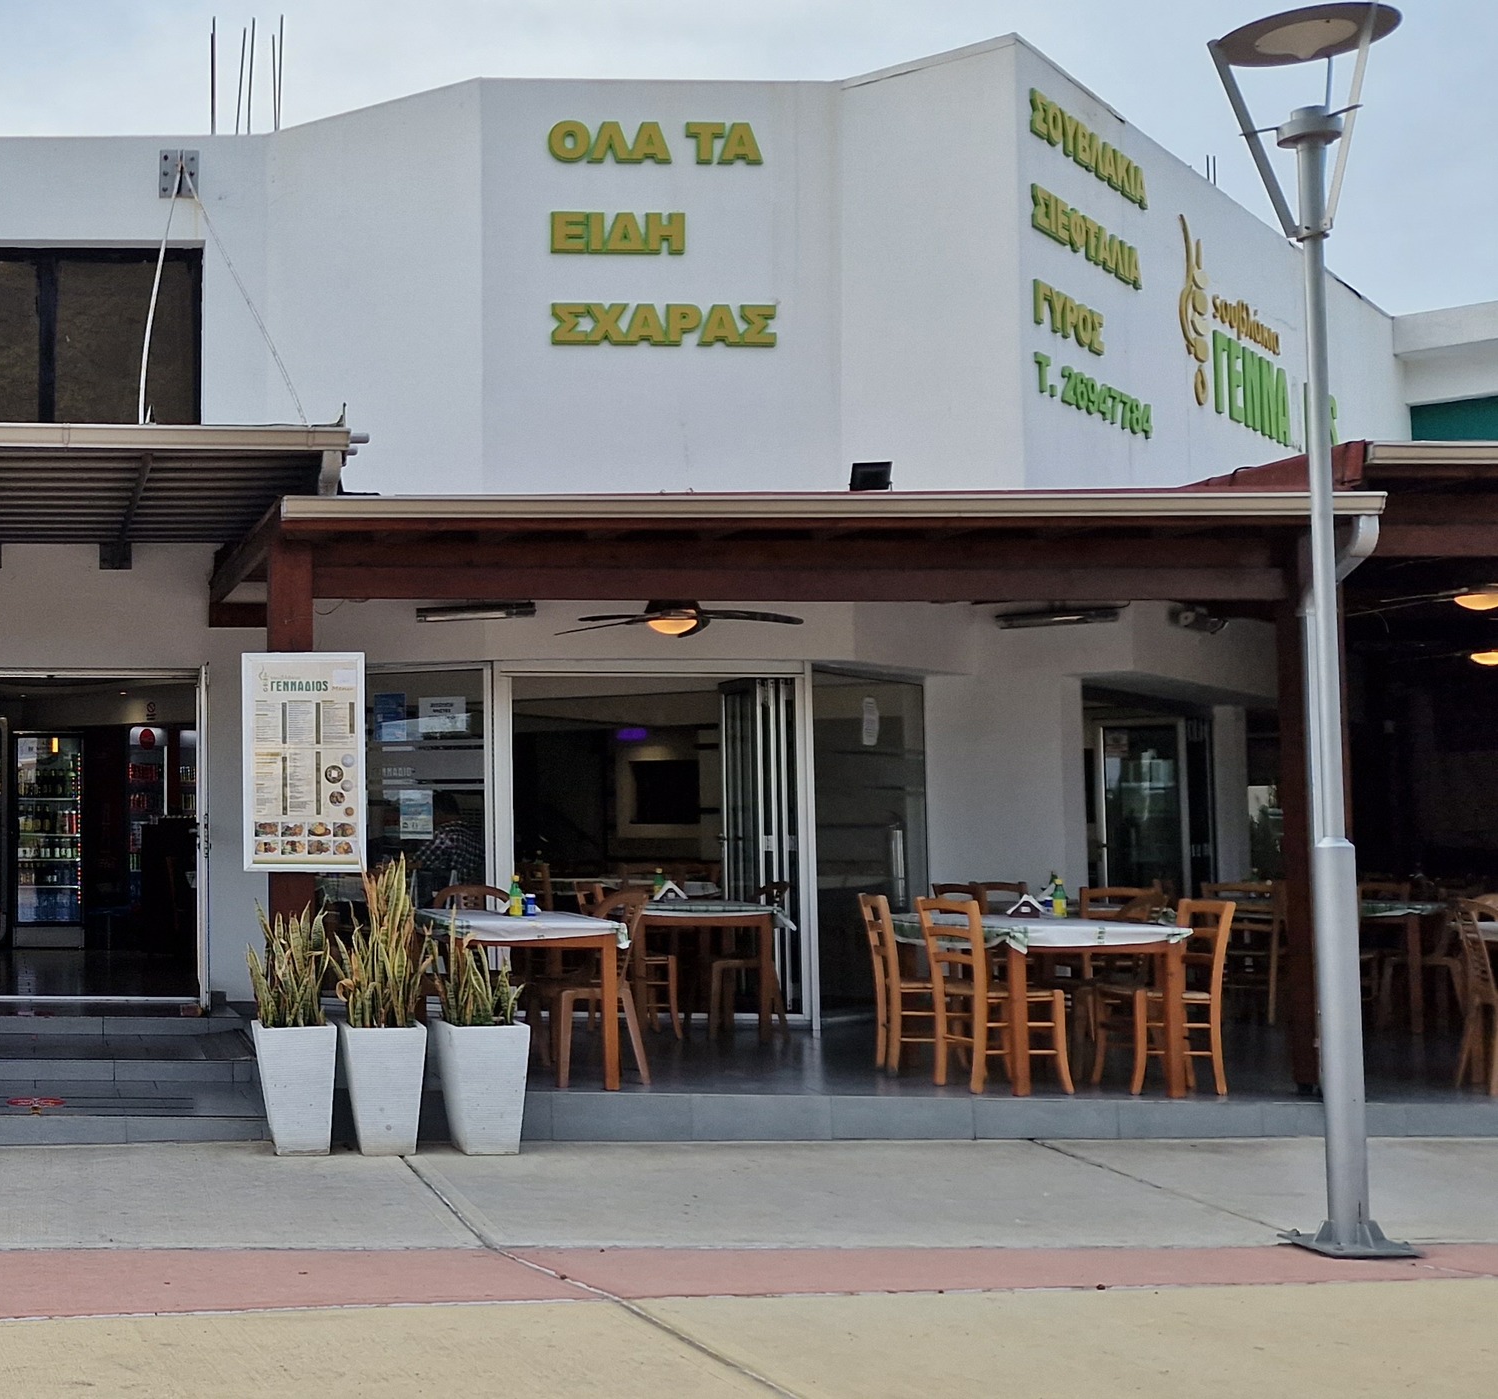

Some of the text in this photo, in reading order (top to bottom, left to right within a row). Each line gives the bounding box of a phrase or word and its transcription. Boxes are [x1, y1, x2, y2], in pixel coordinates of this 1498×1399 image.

[548, 120, 763, 166] ΟΛΑ ΤΑ
[1029, 87, 1148, 210] ΣΟΥΒΛΑΚΙΑ
[550, 211, 686, 255] ΕΙΔΗ
[1030, 183, 1142, 290] ΣΙΕΦΤΑΛΙΑ
[551, 302, 777, 347] ΣΧΑΡΑΣ
[1033, 278, 1105, 356] ΓΥΡΟΣ
[1034, 351, 1153, 440] Τ. 26947784
